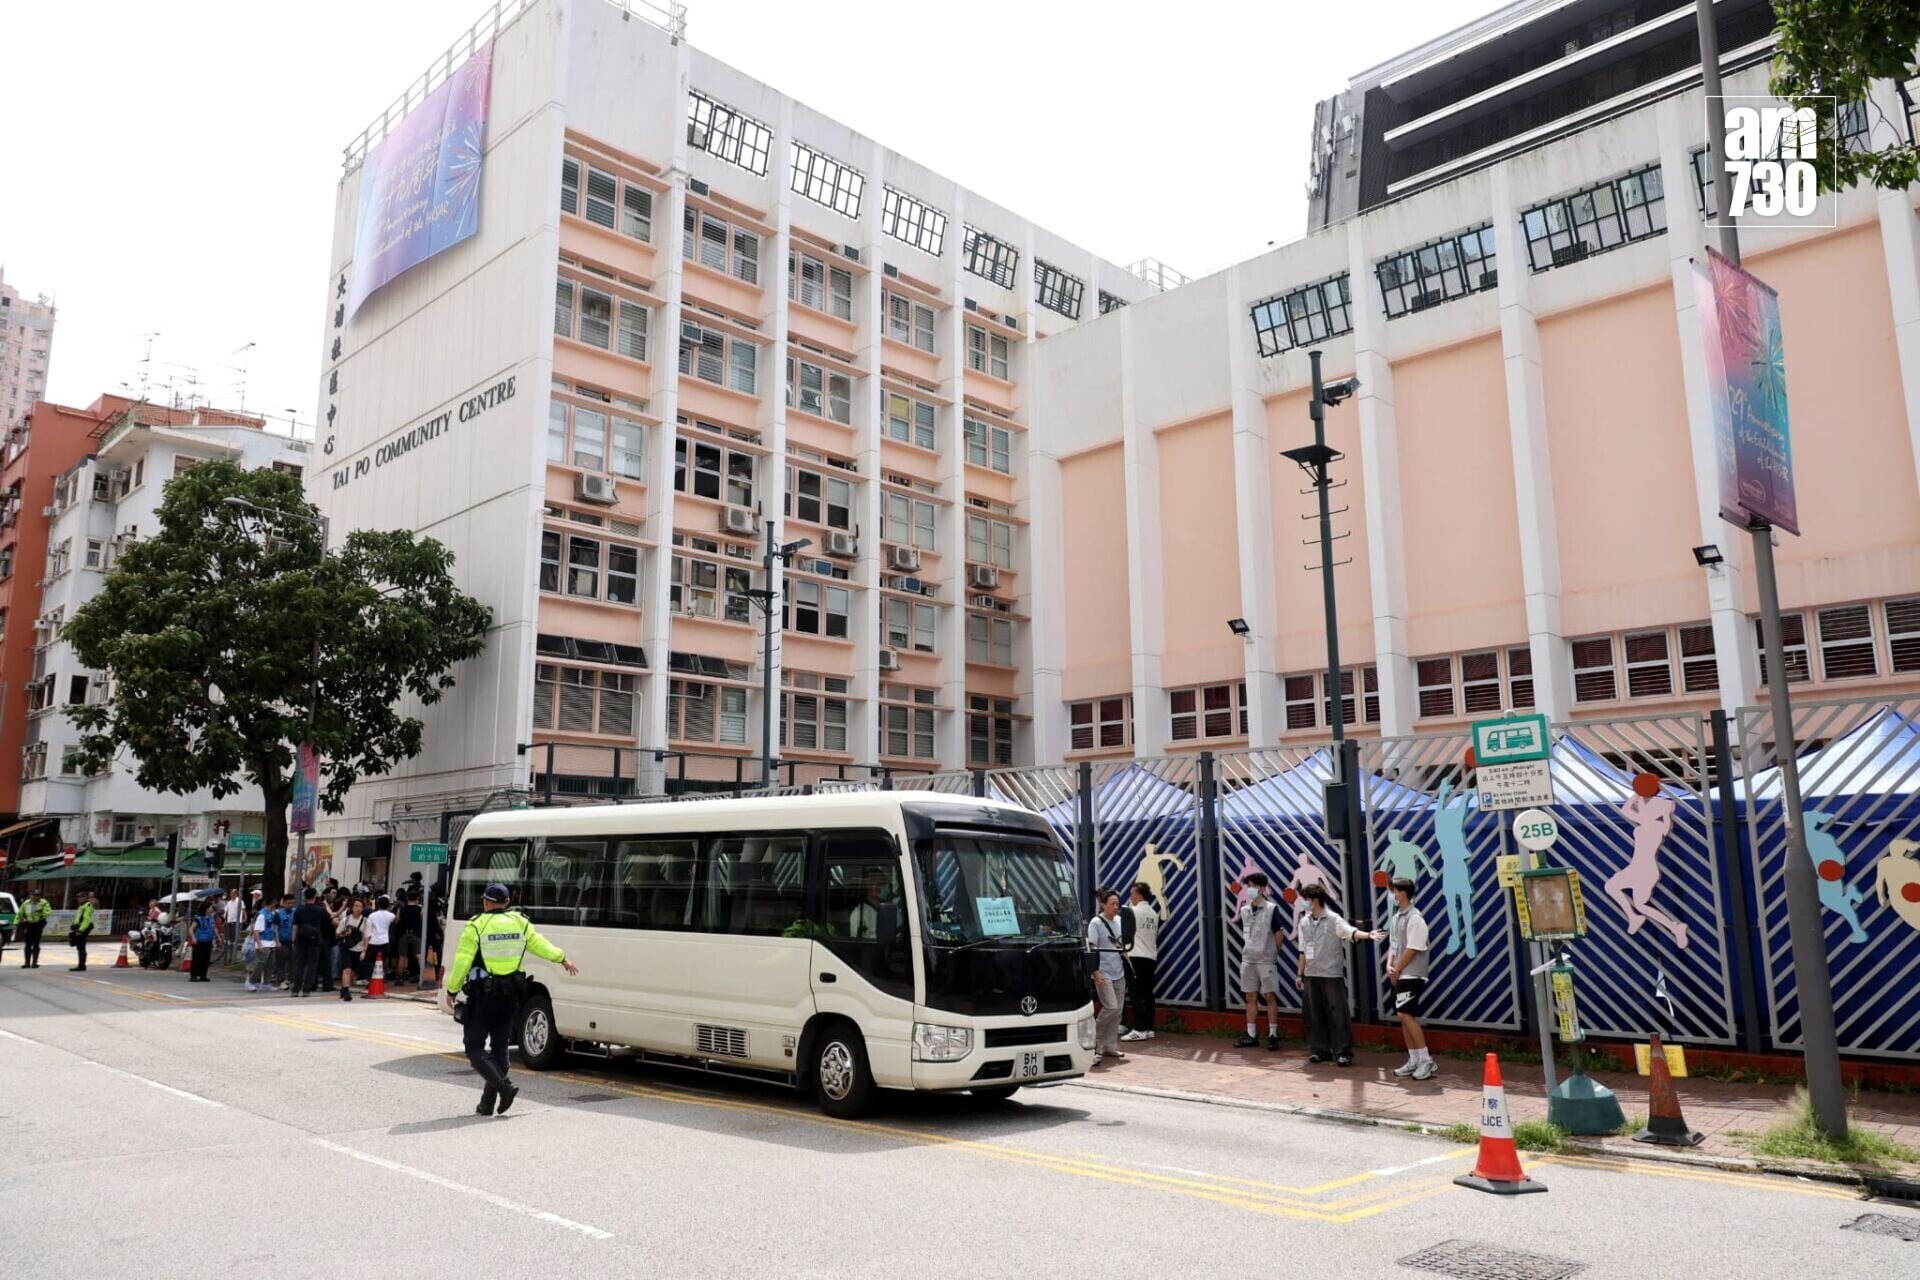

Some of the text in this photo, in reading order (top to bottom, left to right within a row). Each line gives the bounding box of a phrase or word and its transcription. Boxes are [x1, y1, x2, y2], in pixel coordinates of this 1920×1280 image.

[323, 273, 347, 456] 大埔社區中心
[333, 376, 516, 490] TAI PO COMMUNITY CENTRE
[1520, 822, 1554, 839] 25B
[1024, 1052, 1037, 1065] BH
[1022, 1064, 1038, 1077] 310
